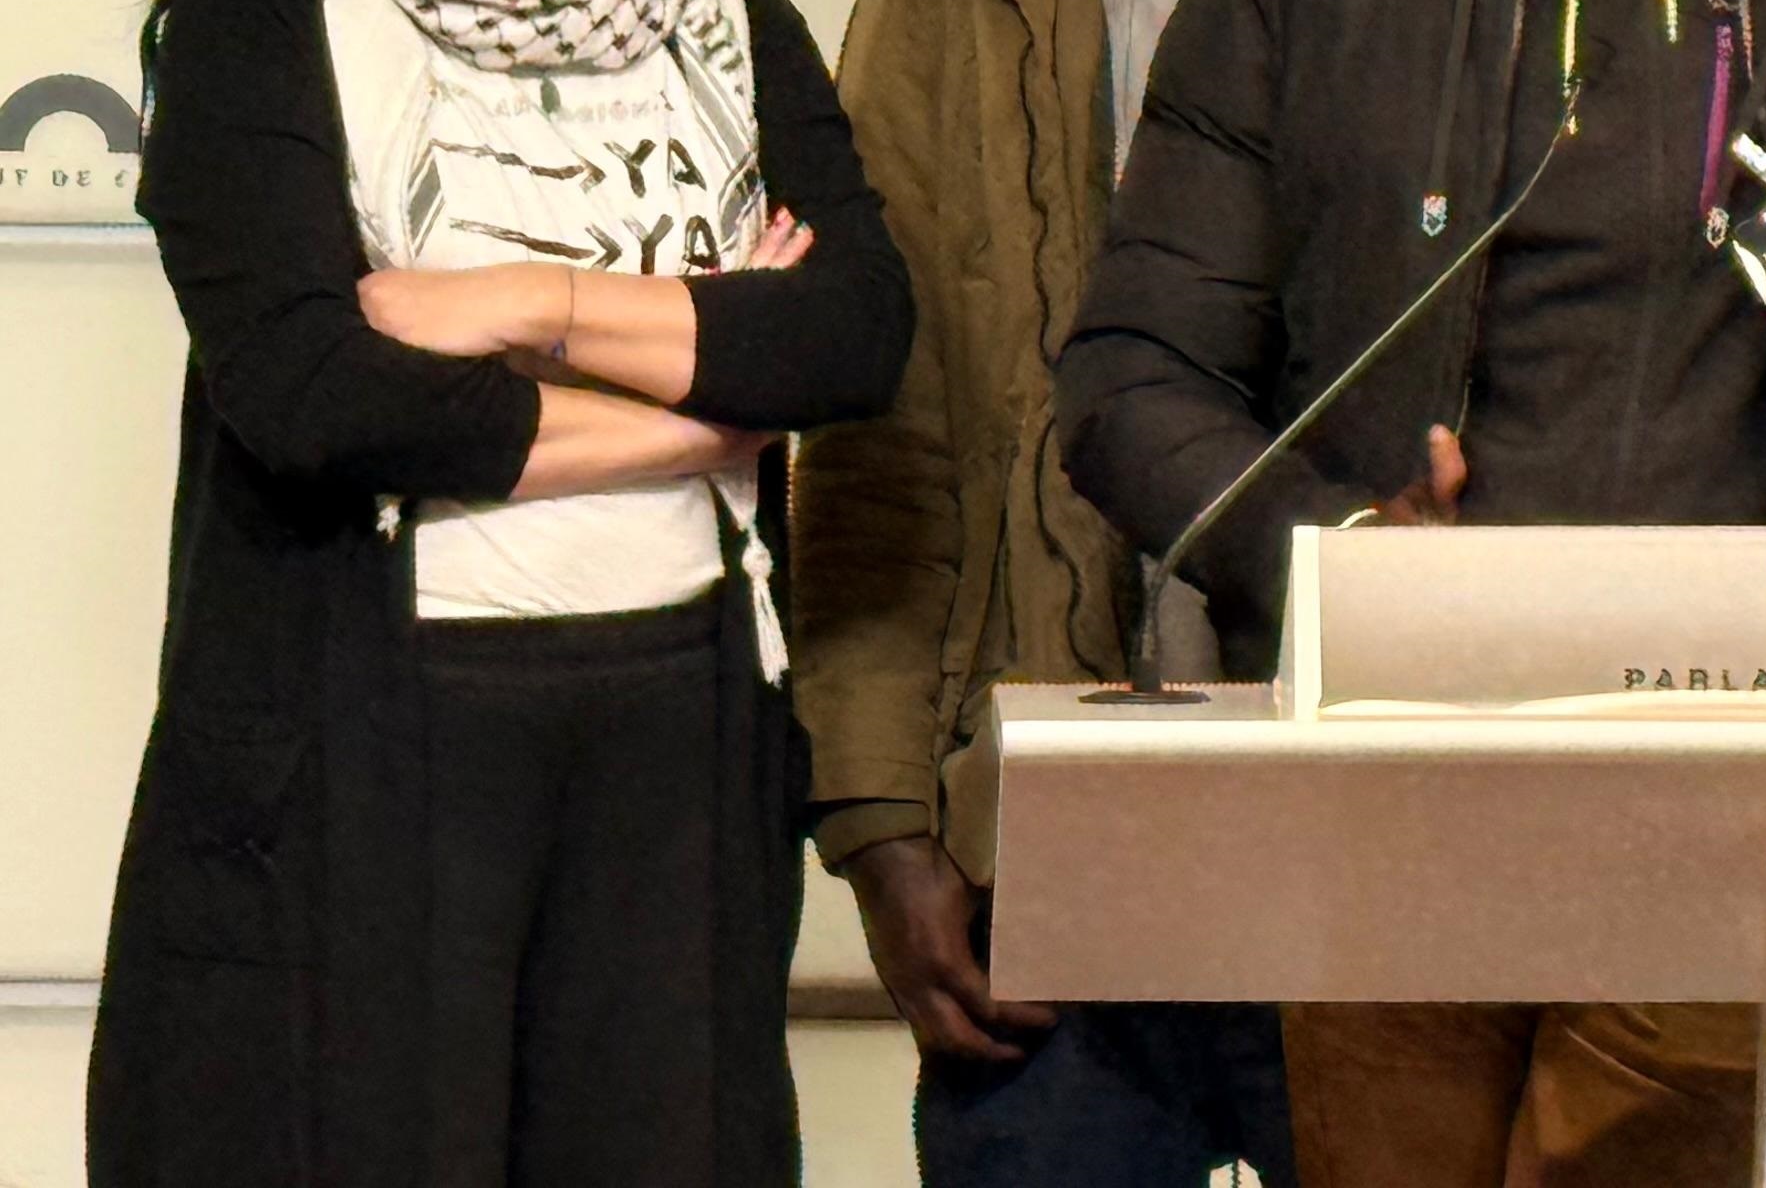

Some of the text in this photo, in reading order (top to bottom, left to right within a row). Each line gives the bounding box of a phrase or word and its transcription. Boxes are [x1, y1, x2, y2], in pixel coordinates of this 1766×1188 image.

[51, 169, 92, 188] DE
[603, 138, 707, 199] YA
[622, 213, 721, 275] YA
